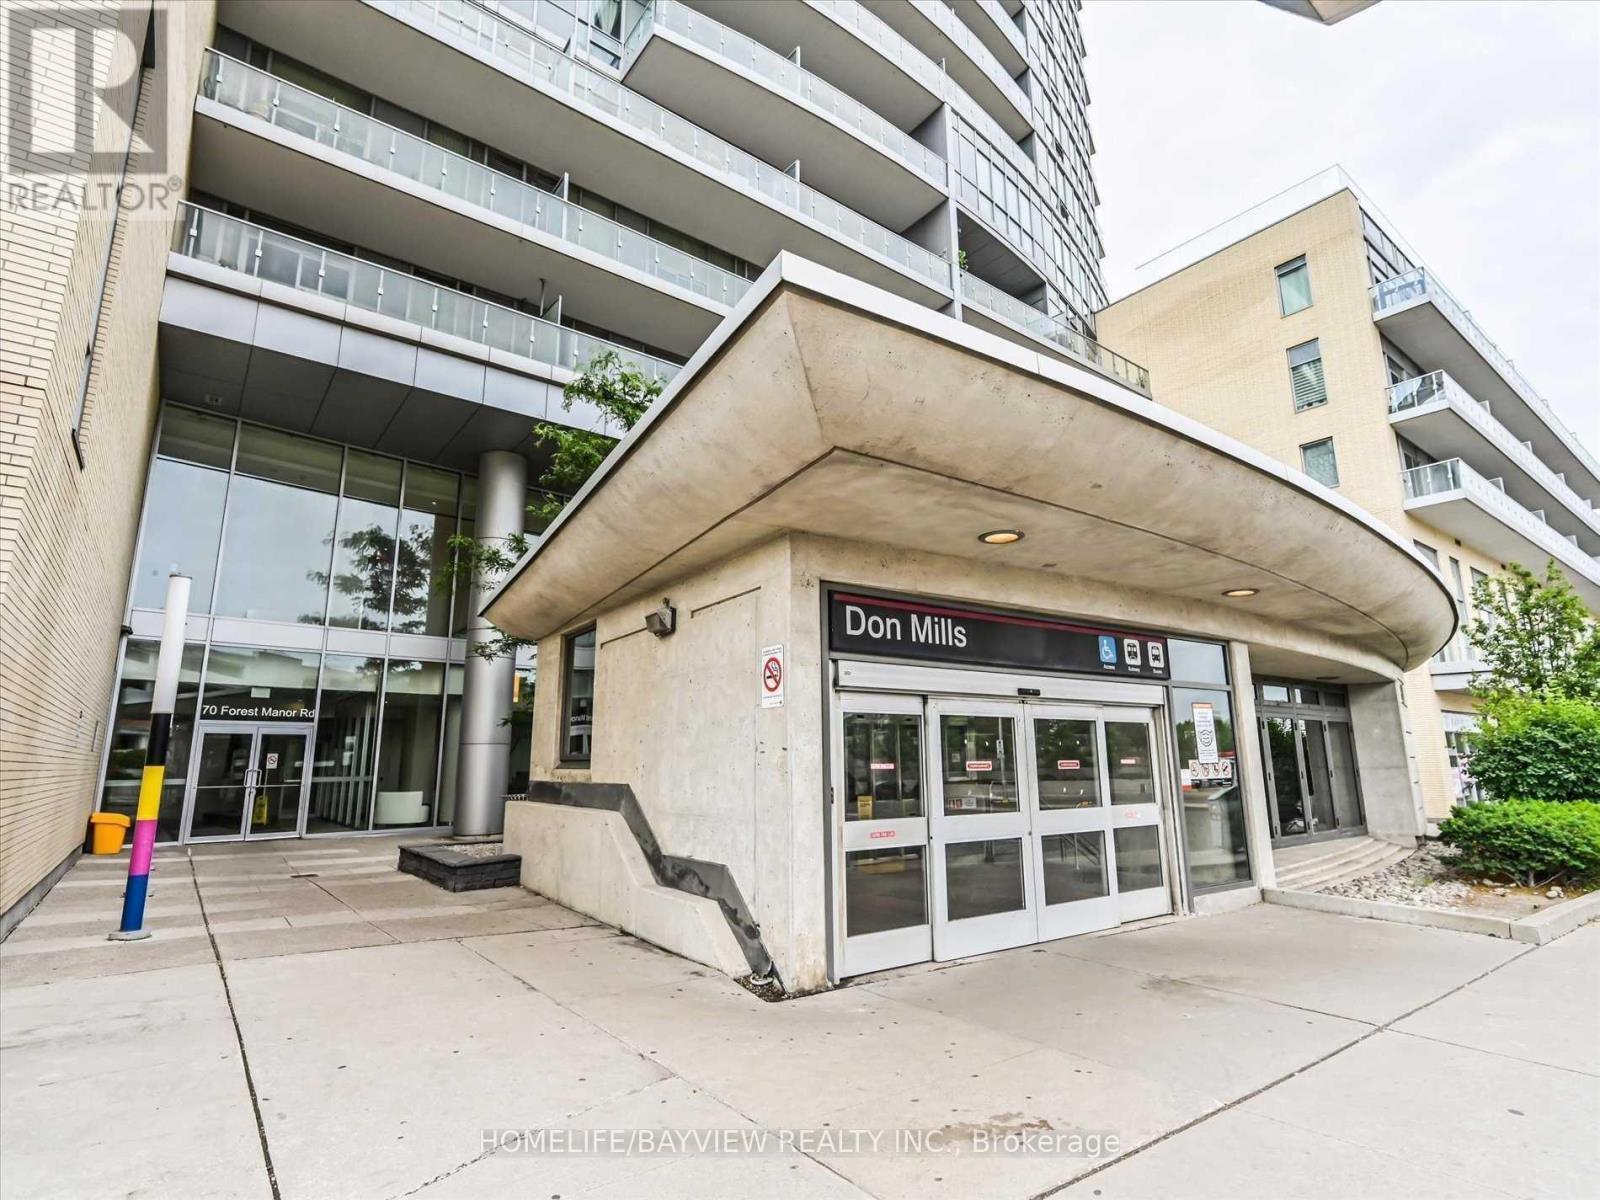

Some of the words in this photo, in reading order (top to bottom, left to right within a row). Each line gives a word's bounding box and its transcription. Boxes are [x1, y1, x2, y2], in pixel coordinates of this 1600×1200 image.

[845, 604, 902, 641] Don
[910, 613, 968, 648] Mills
[202, 705, 218, 715] 70
[220, 705, 259, 717] Forest
[261, 707, 297, 718] Manor
[300, 708, 315, 718] Rd
